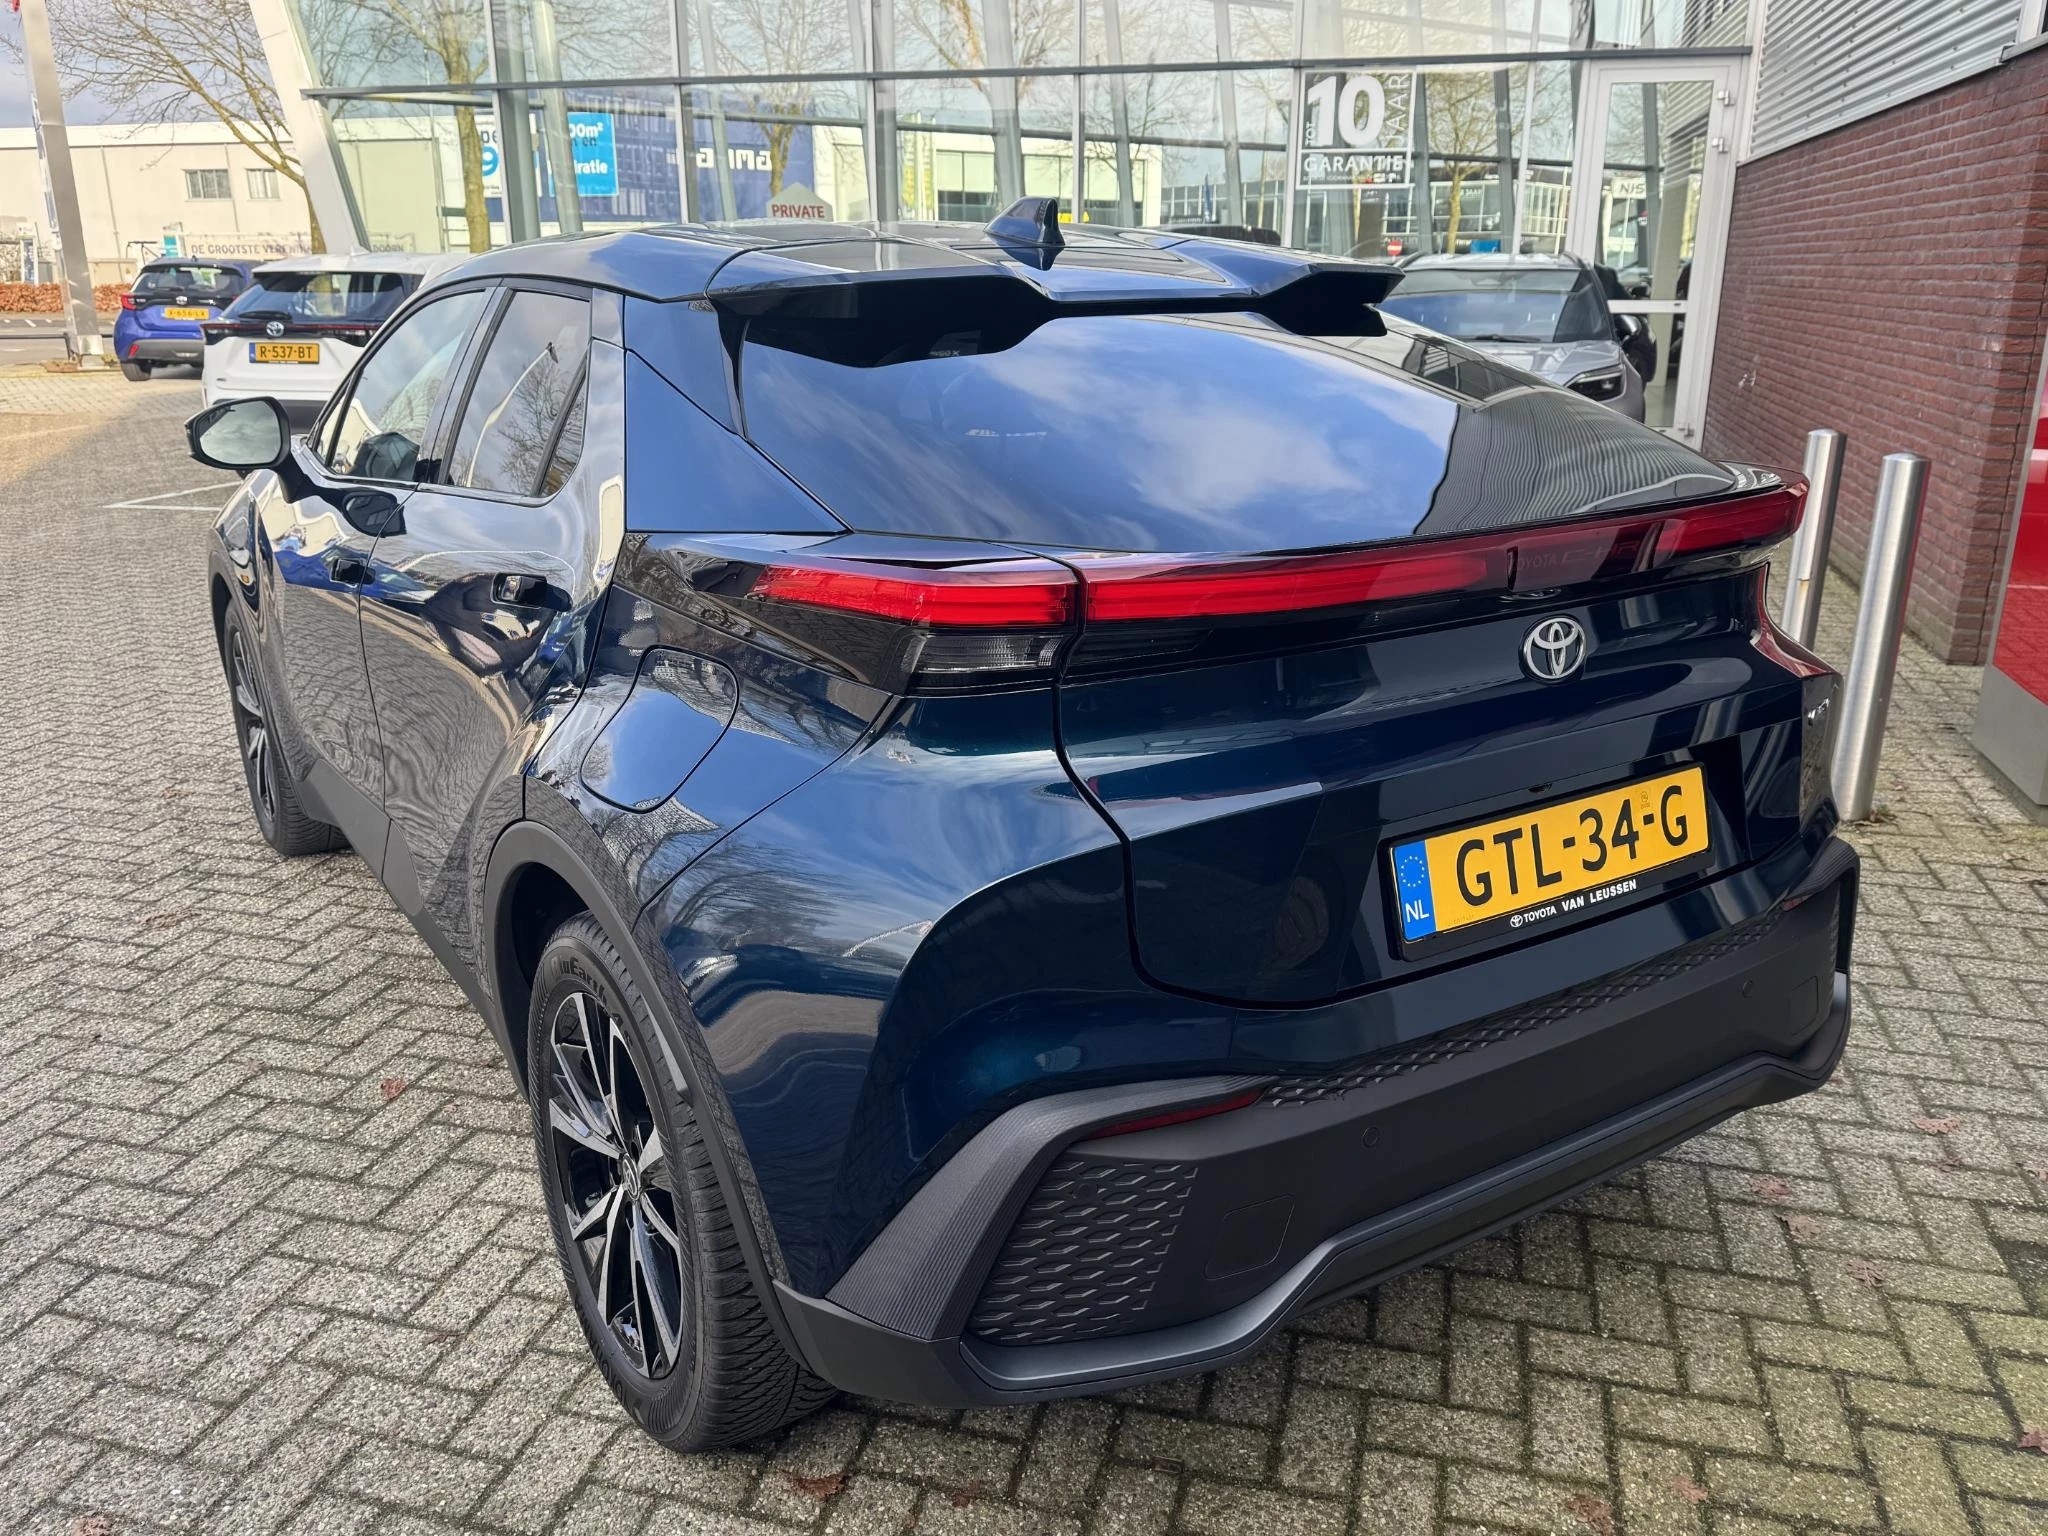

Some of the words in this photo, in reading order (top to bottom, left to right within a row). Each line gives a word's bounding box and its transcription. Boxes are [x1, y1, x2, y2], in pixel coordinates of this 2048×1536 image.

[1307, 75, 1385, 147] 10
[1386, 74, 1409, 144] JAAR
[1304, 155, 1404, 172] GARANTIE
[771, 204, 825, 219] PRIVATE
[191, 244, 205, 254] DE
[207, 244, 260, 254] GROOTSTE
[260, 345, 313, 359] R-537-BT
[1456, 785, 1688, 906] GTL-34-G
[1523, 905, 1557, 923] TOYOTA
[1562, 896, 1585, 911] VAN
[1590, 879, 1637, 903] LEUSSEN
[1404, 900, 1430, 923] NL
